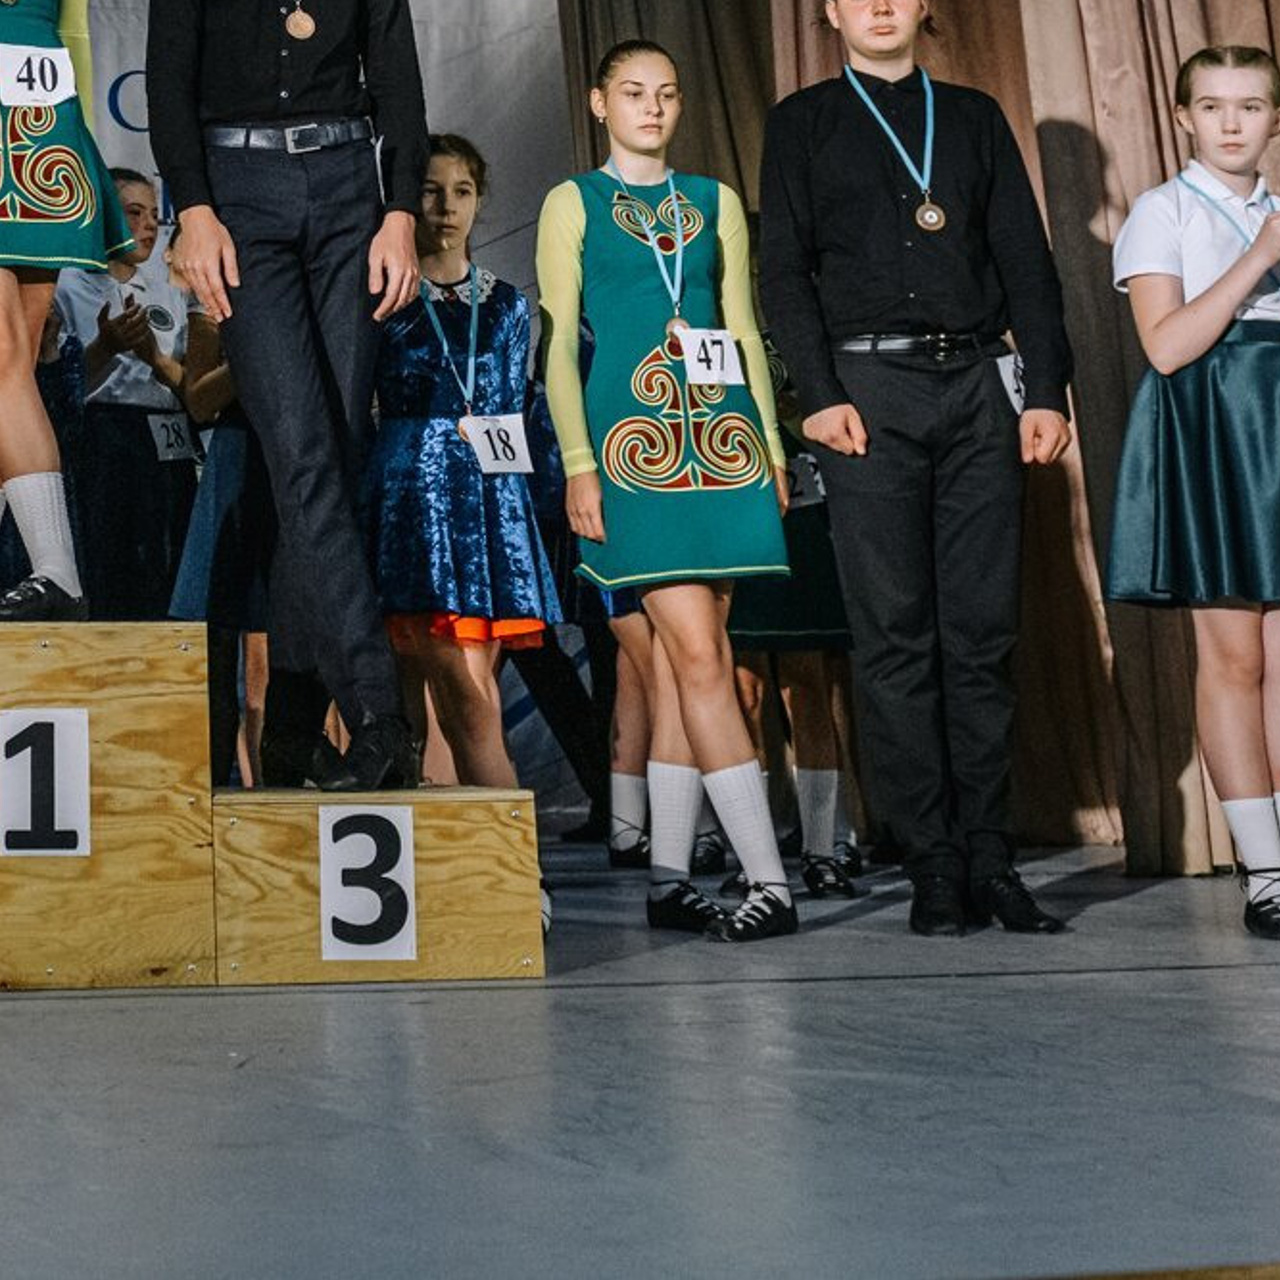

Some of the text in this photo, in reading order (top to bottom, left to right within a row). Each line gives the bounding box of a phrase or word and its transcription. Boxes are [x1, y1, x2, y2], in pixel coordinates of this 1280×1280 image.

[16, 55, 59, 93] 40
[696, 338, 725, 371] 47
[160, 421, 186, 449] 28
[482, 426, 517, 462] 18
[4, 721, 79, 851] 1
[331, 813, 410, 947] 3
